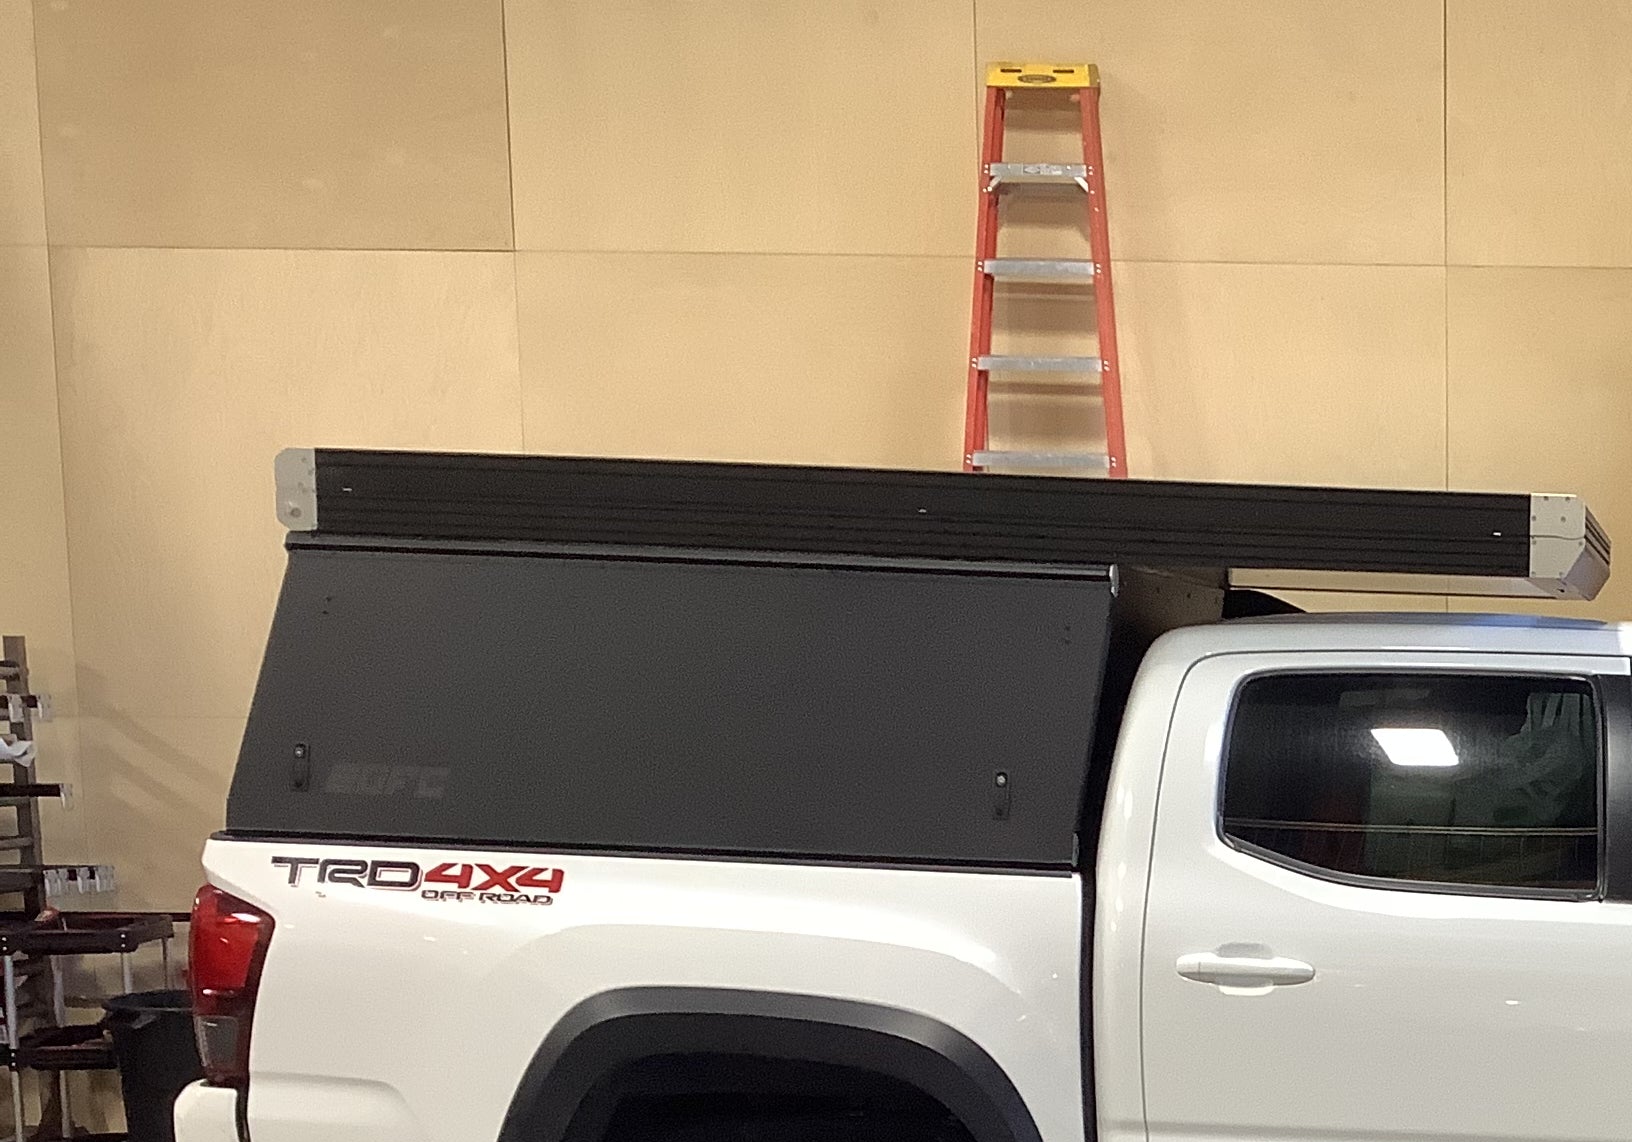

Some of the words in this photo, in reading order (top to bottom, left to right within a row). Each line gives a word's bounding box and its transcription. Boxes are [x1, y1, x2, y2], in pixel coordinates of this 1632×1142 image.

[271, 855, 422, 890] TRD
[421, 890, 477, 902] OFF
[479, 892, 554, 905] ROAD
